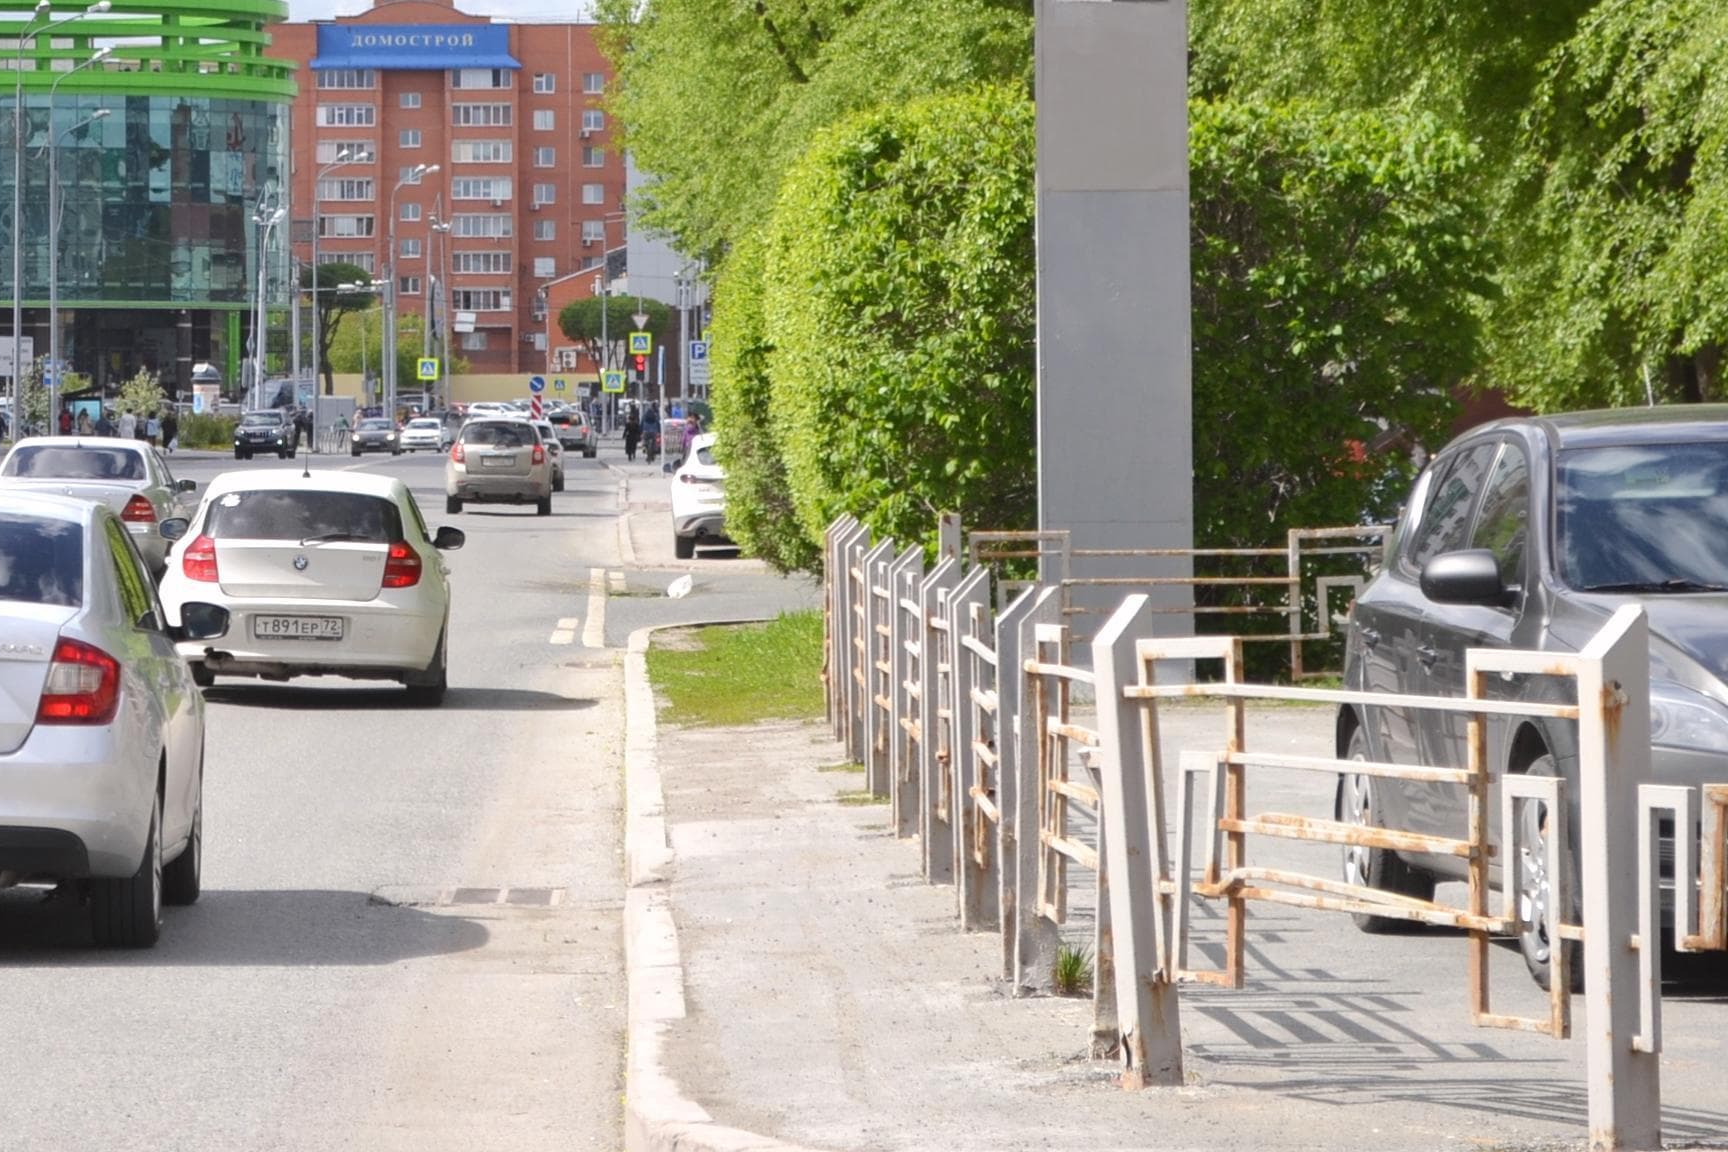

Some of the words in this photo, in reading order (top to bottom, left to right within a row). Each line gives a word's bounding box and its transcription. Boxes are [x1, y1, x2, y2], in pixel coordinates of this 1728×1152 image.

[351, 33, 475, 47] ДОМОСТРОЙ
[694, 344, 706, 359] P
[323, 619, 338, 632] 72
